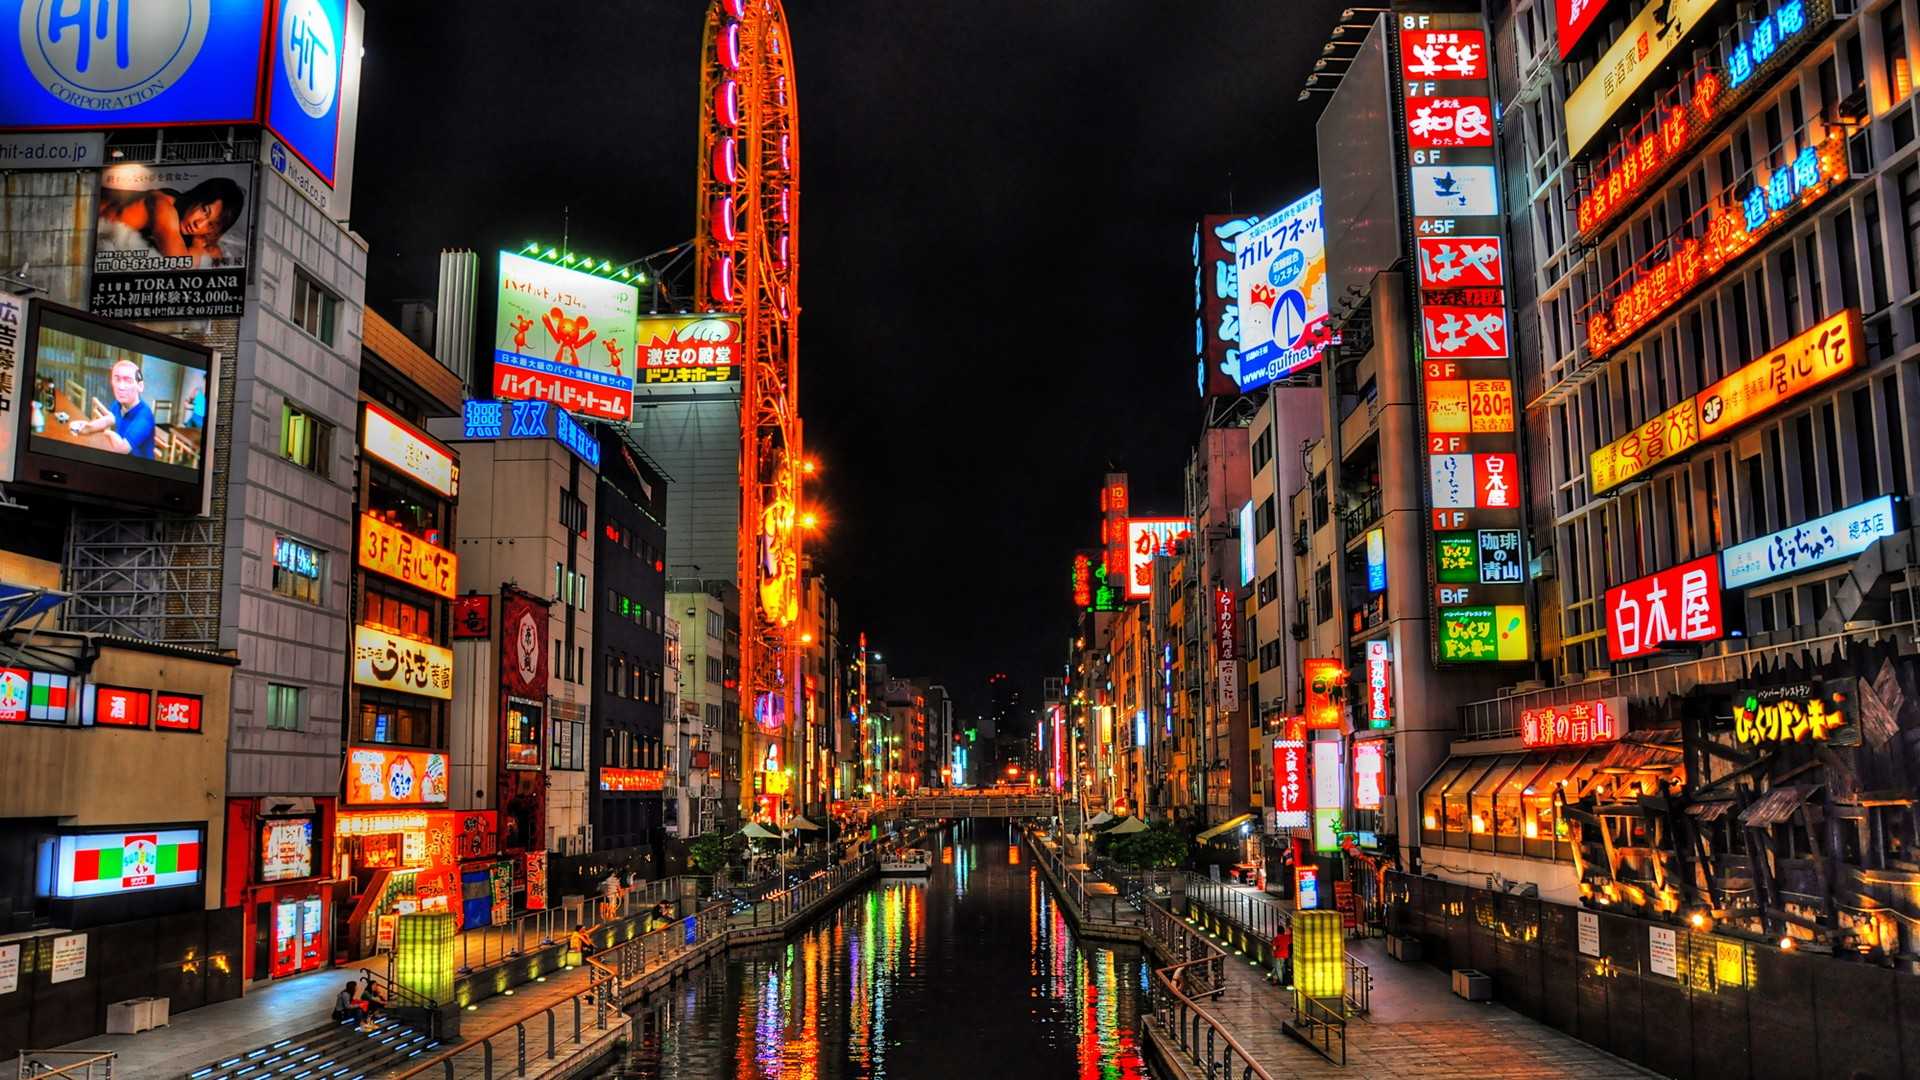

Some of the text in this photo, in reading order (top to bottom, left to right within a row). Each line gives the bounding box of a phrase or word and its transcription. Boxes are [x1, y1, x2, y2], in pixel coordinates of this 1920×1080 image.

[1403, 16, 1430, 29] 8F
[49, 79, 165, 110] CORPORATION
[1408, 83, 1435, 96] 7F
[1409, 106, 1490, 138] 和民
[1414, 151, 1440, 164] 6F
[287, 161, 327, 209] hit-ad.co.jp
[112, 257, 192, 270] 06-6214-7845
[1421, 244, 1498, 282] はや
[1274, 264, 1300, 284] システム
[99, 283, 131, 292] CLUB
[135, 278, 175, 291] TORA
[180, 277, 203, 289] NO
[1425, 314, 1503, 352] はや
[646, 347, 731, 366] 激安の殿堂
[1429, 364, 1455, 377] 3F
[501, 373, 625, 415] バイトルドットコム
[1474, 382, 1506, 392] 全品
[1472, 394, 1512, 416] 280円
[1703, 396, 1722, 424] 3F
[1433, 438, 1460, 451] 2F
[1621, 403, 1697, 478] 鳥貴族
[1484, 455, 1509, 507] 白木屋
[1438, 512, 1464, 527] 1F
[368, 532, 390, 562] 3F
[1442, 545, 1471, 557] びっくり
[1481, 533, 1517, 550] 珈琲
[1441, 557, 1473, 569] ドンキー
[1494, 550, 1507, 561] の
[1483, 561, 1519, 581] 青山
[1440, 588, 1469, 604] B1F
[1615, 568, 1716, 656] 白木屋
[1220, 594, 1233, 659] らーめん専門店
[1446, 620, 1490, 639] びっくり
[1445, 639, 1495, 657] ドンキー
[371, 640, 430, 688] うなぎ
[1758, 685, 1811, 698] ハンバーグレストラン
[111, 696, 127, 719] 酒
[157, 702, 189, 723] たばこ
[1520, 702, 1615, 747] 珈琲の青山
[1733, 699, 1845, 746] びっくりドンキー
